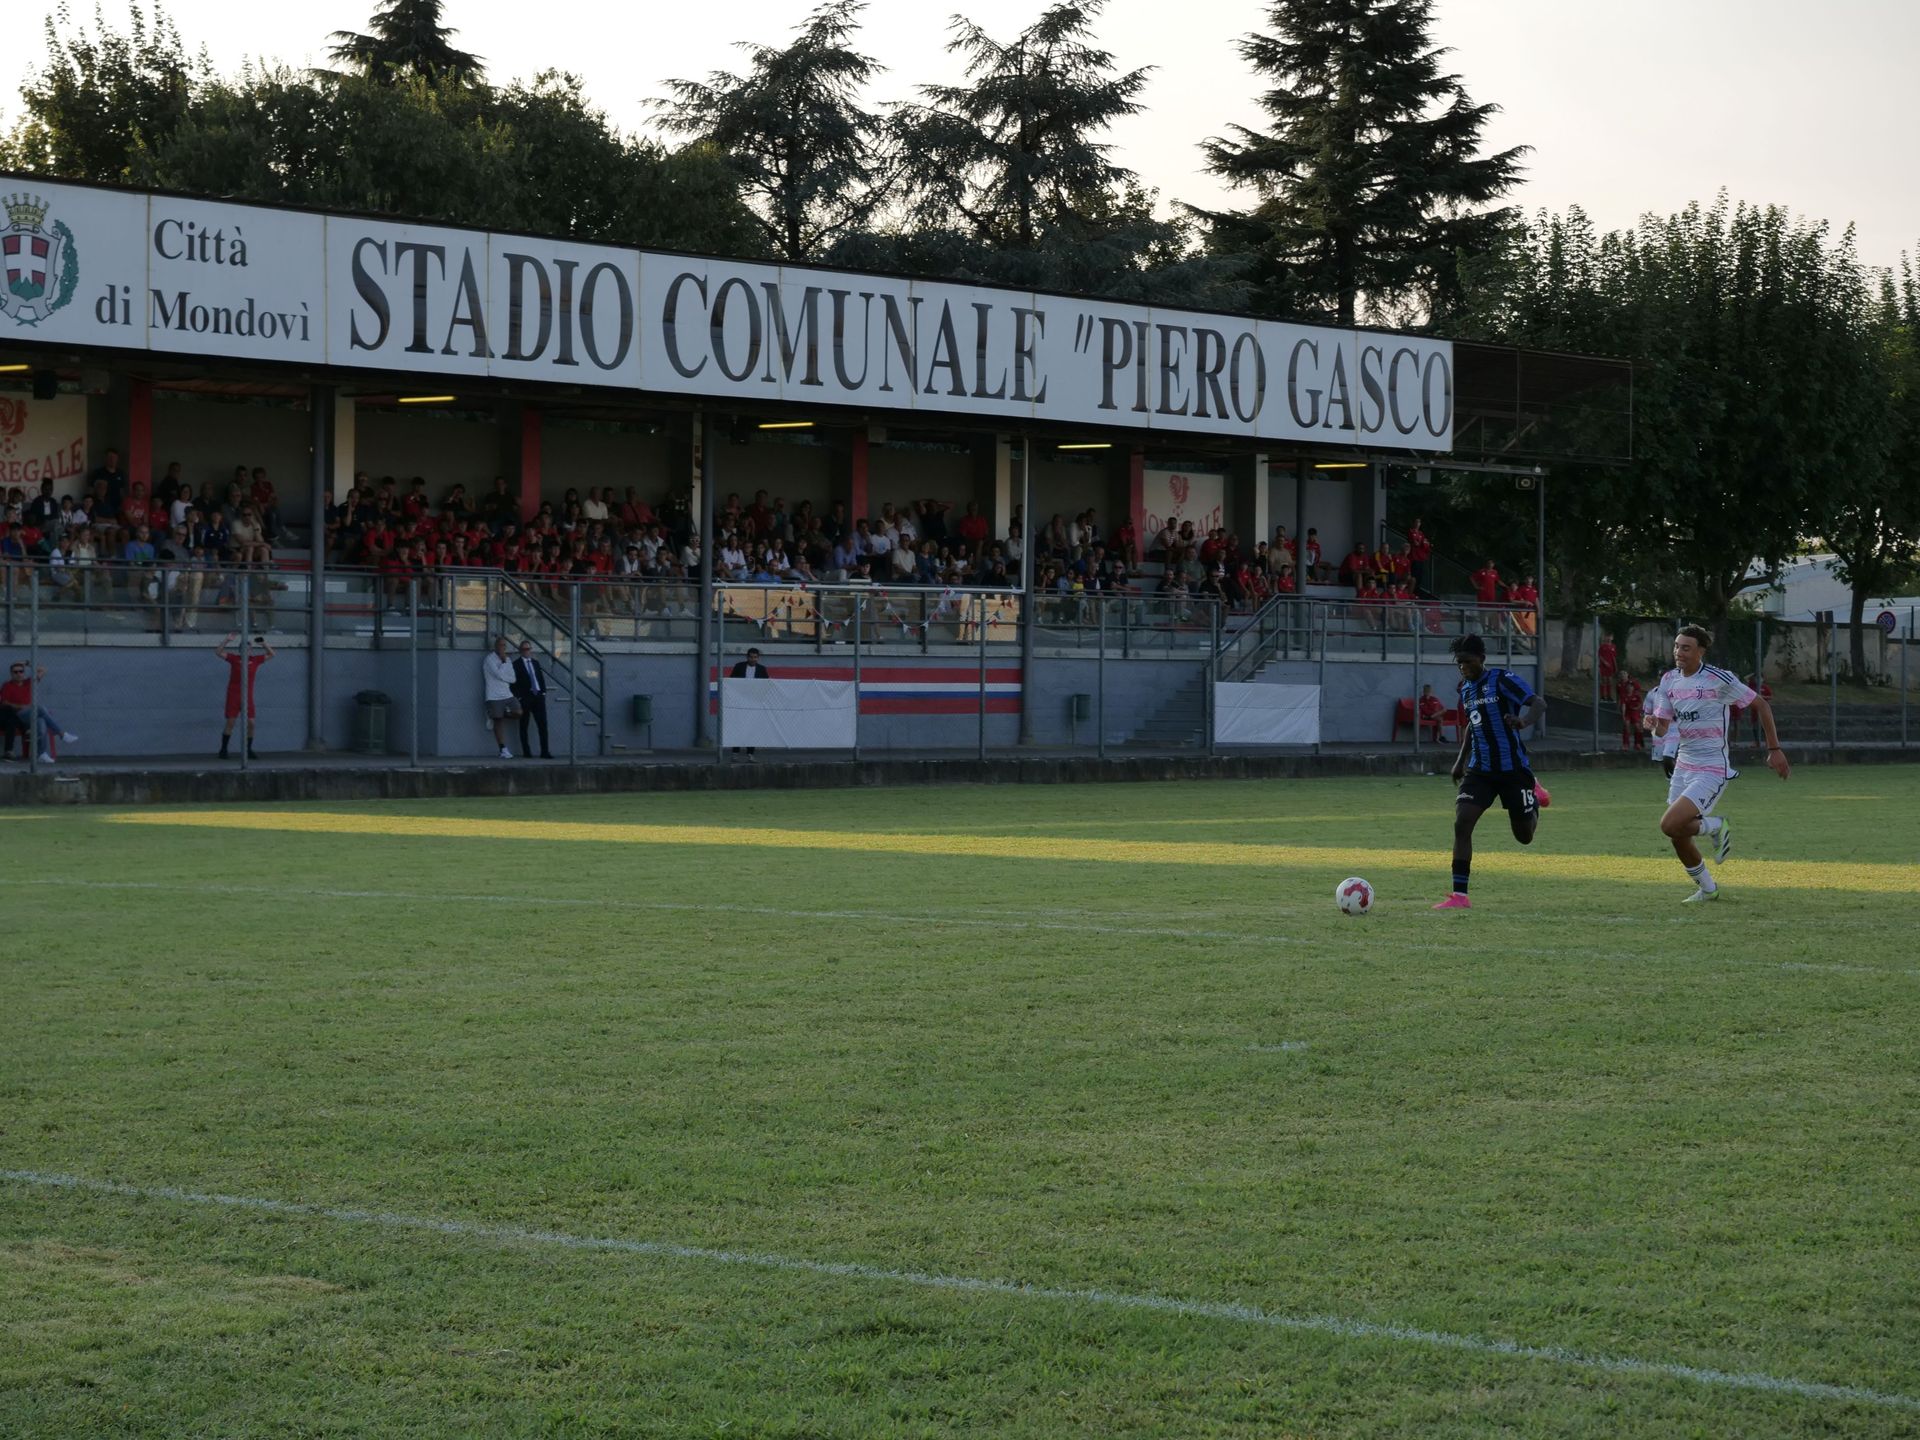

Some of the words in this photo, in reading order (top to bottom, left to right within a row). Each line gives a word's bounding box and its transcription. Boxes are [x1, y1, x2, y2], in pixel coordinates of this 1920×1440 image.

[154, 219, 248, 267] Città
[95, 285, 132, 326] di
[149, 289, 310, 342] Mondovì
[350, 236, 633, 371] STADIO
[662, 272, 1047, 403] COMUNALE
[1286, 338, 1452, 438] GASCO
